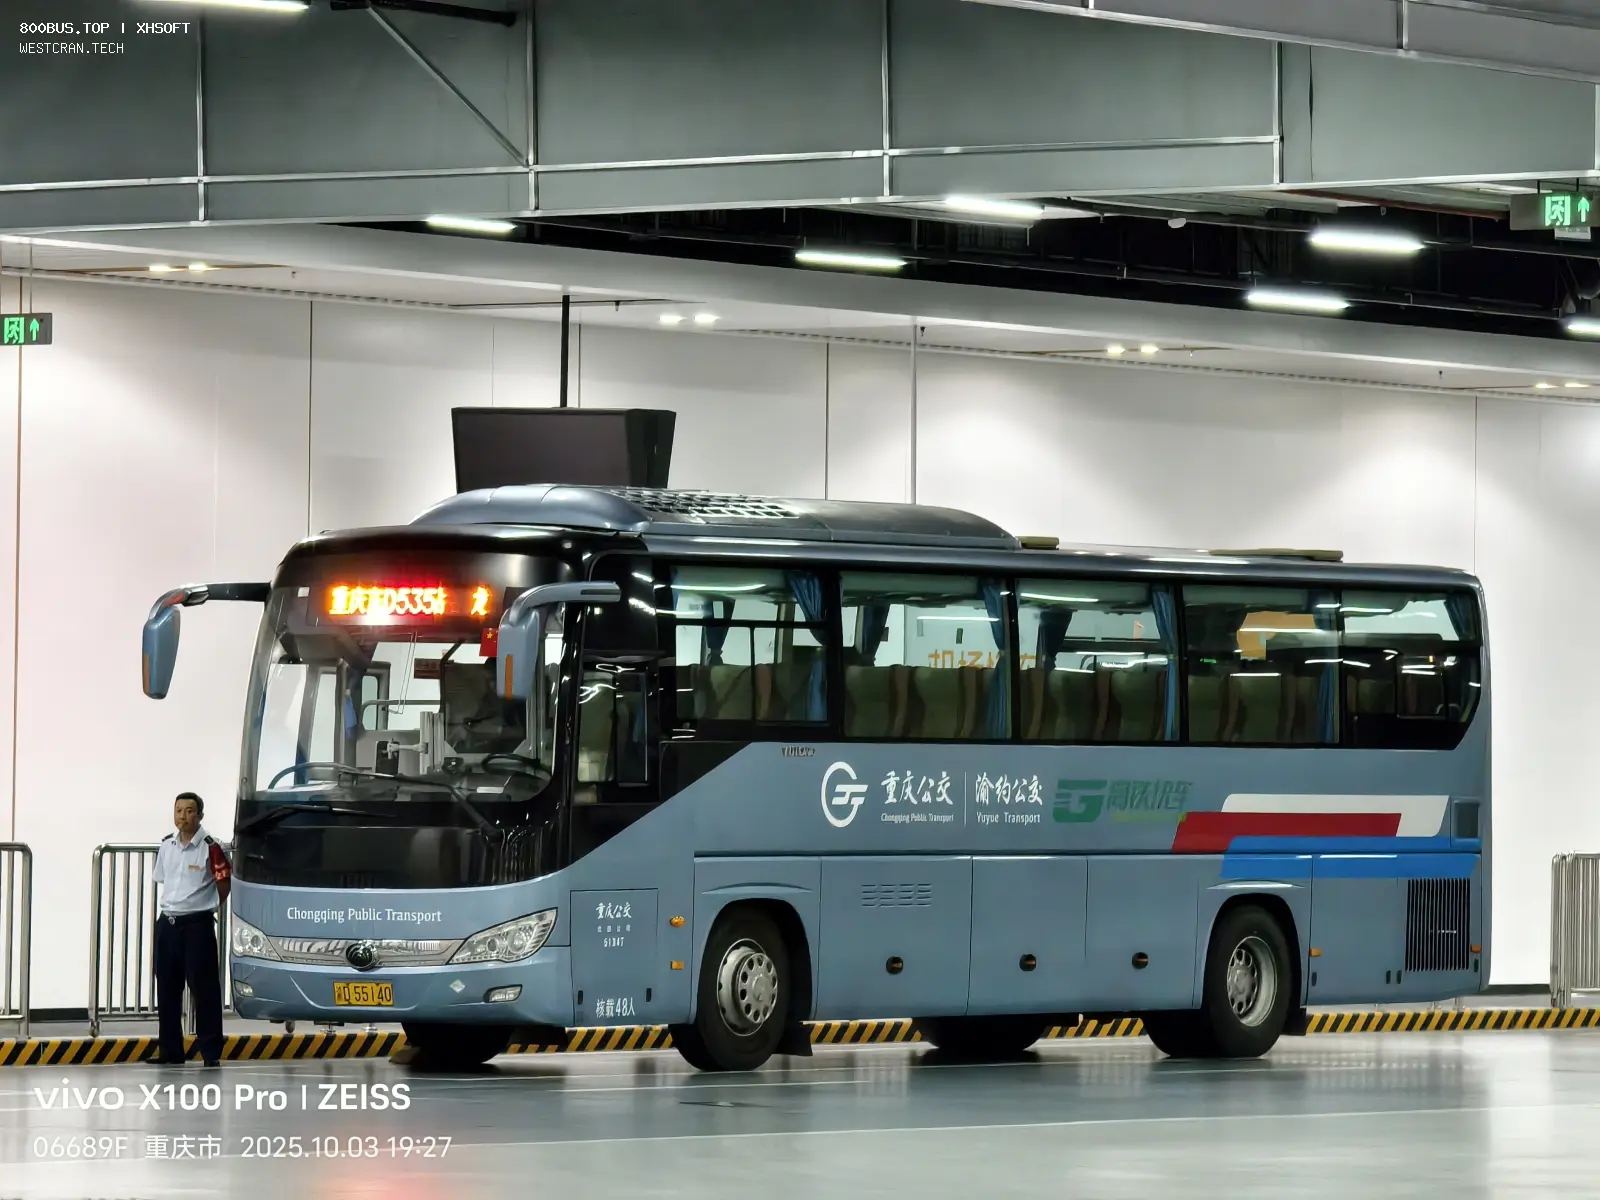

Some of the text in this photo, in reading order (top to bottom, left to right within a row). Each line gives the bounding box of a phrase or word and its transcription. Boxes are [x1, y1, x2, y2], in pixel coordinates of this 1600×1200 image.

[880, 770, 954, 805] 重庆公交
[975, 772, 1043, 807] 渝约公交
[880, 812, 954, 824] Chongqing Public Transport
[976, 812, 1041, 825] Yuyue Transport
[287, 907, 442, 924] Chongqing Public Transport
[595, 901, 632, 920] 重庆公交
[595, 996, 636, 1019] 核载48人
